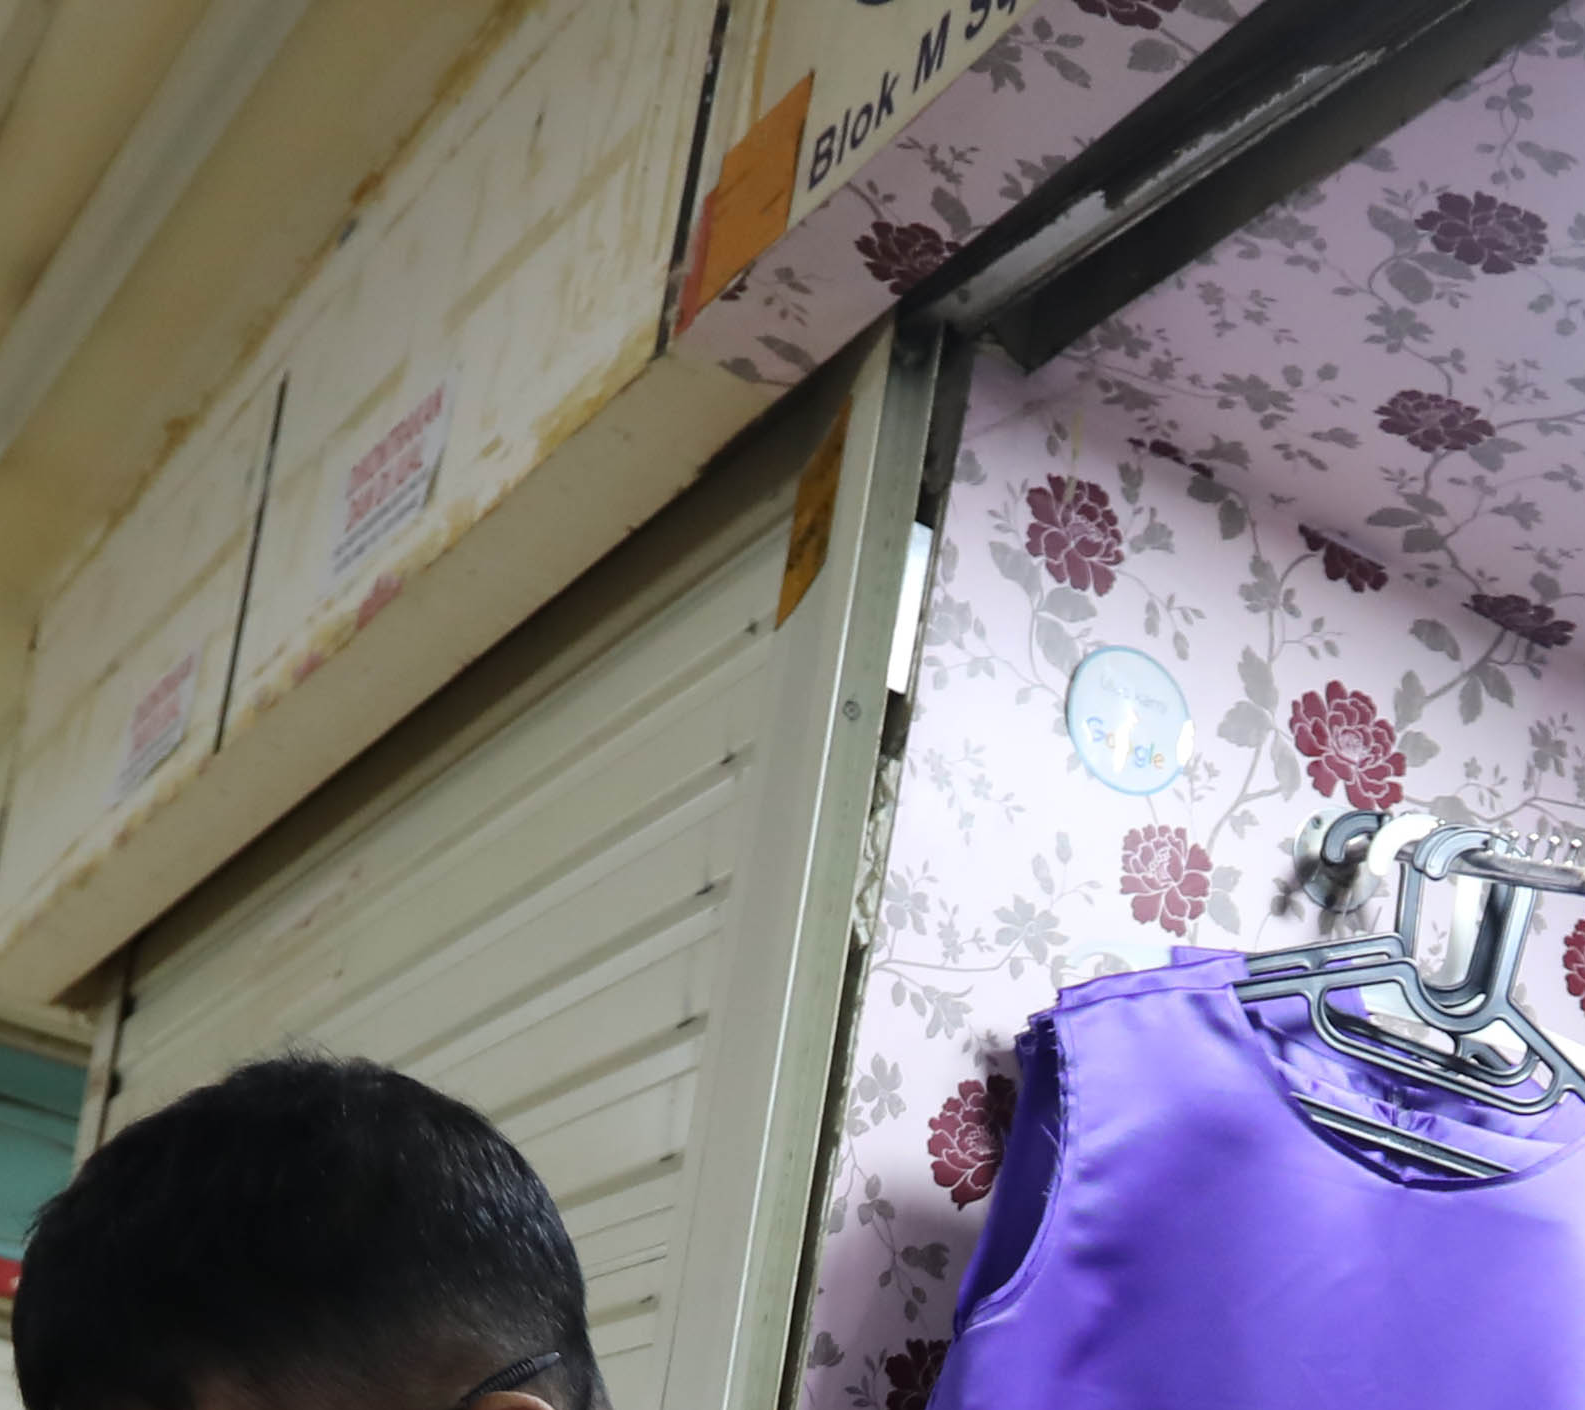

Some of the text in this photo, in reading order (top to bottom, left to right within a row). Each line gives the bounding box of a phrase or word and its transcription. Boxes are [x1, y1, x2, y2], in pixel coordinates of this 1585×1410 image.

[808, 71, 899, 189] Blok
[913, 10, 951, 93] M
[1085, 716, 1165, 769] Gogle
